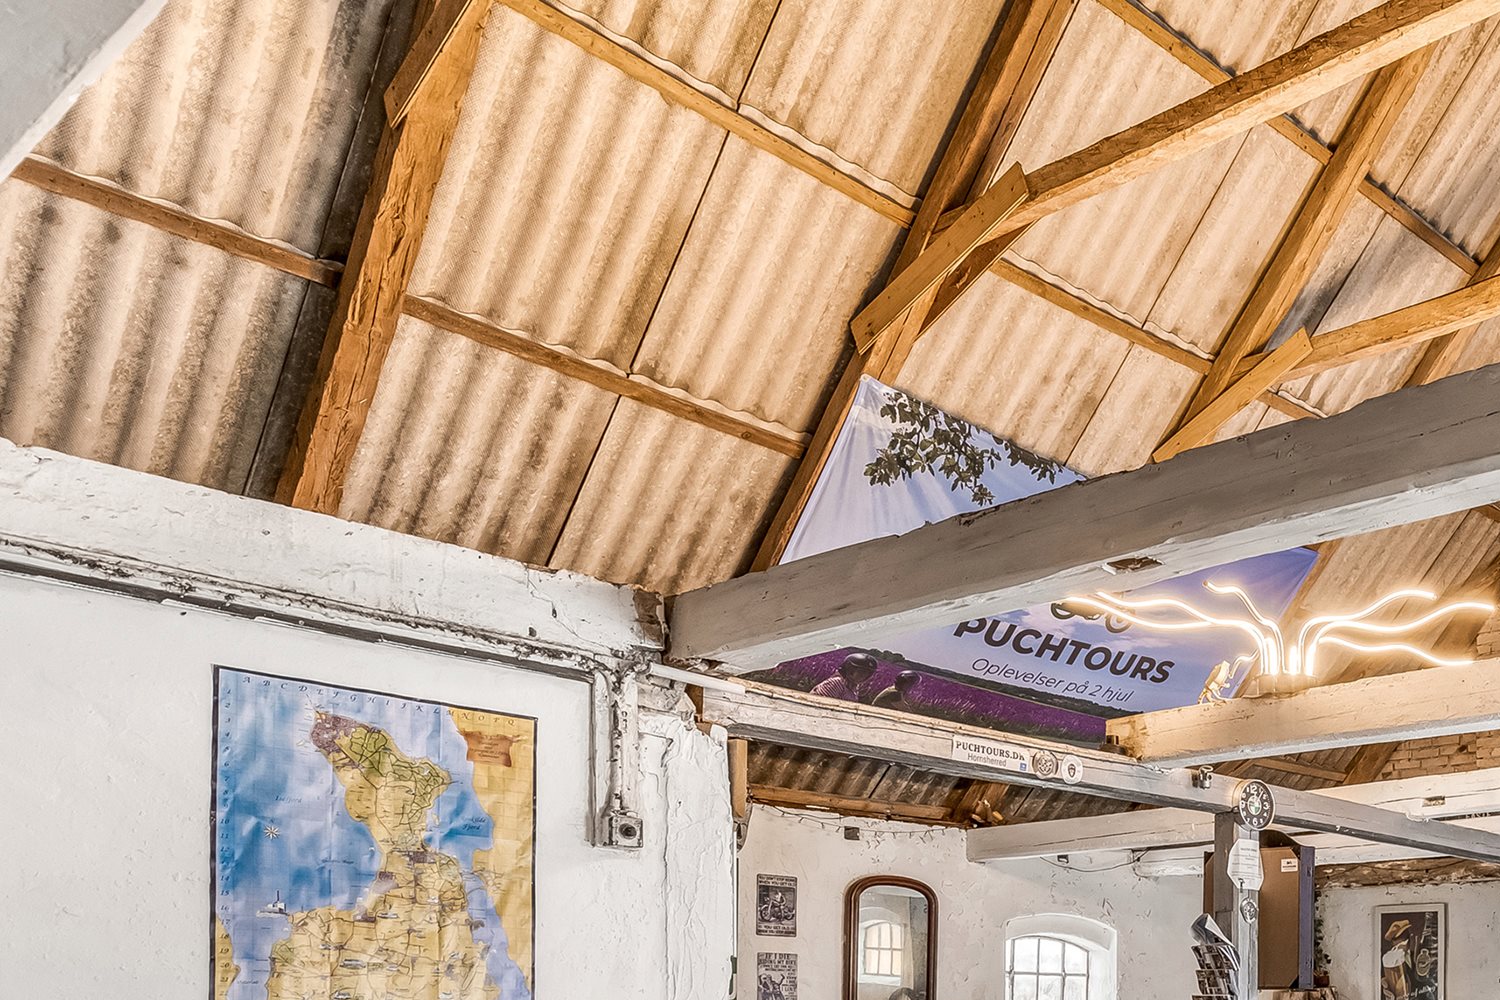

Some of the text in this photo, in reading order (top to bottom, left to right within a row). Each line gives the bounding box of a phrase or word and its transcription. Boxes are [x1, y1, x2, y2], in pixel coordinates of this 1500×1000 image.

[953, 618, 1175, 683] PUCHTOURS
[971, 658, 1134, 703] Oplevelser på 2 hjul
[967, 752, 1007, 768] Hornsherred
